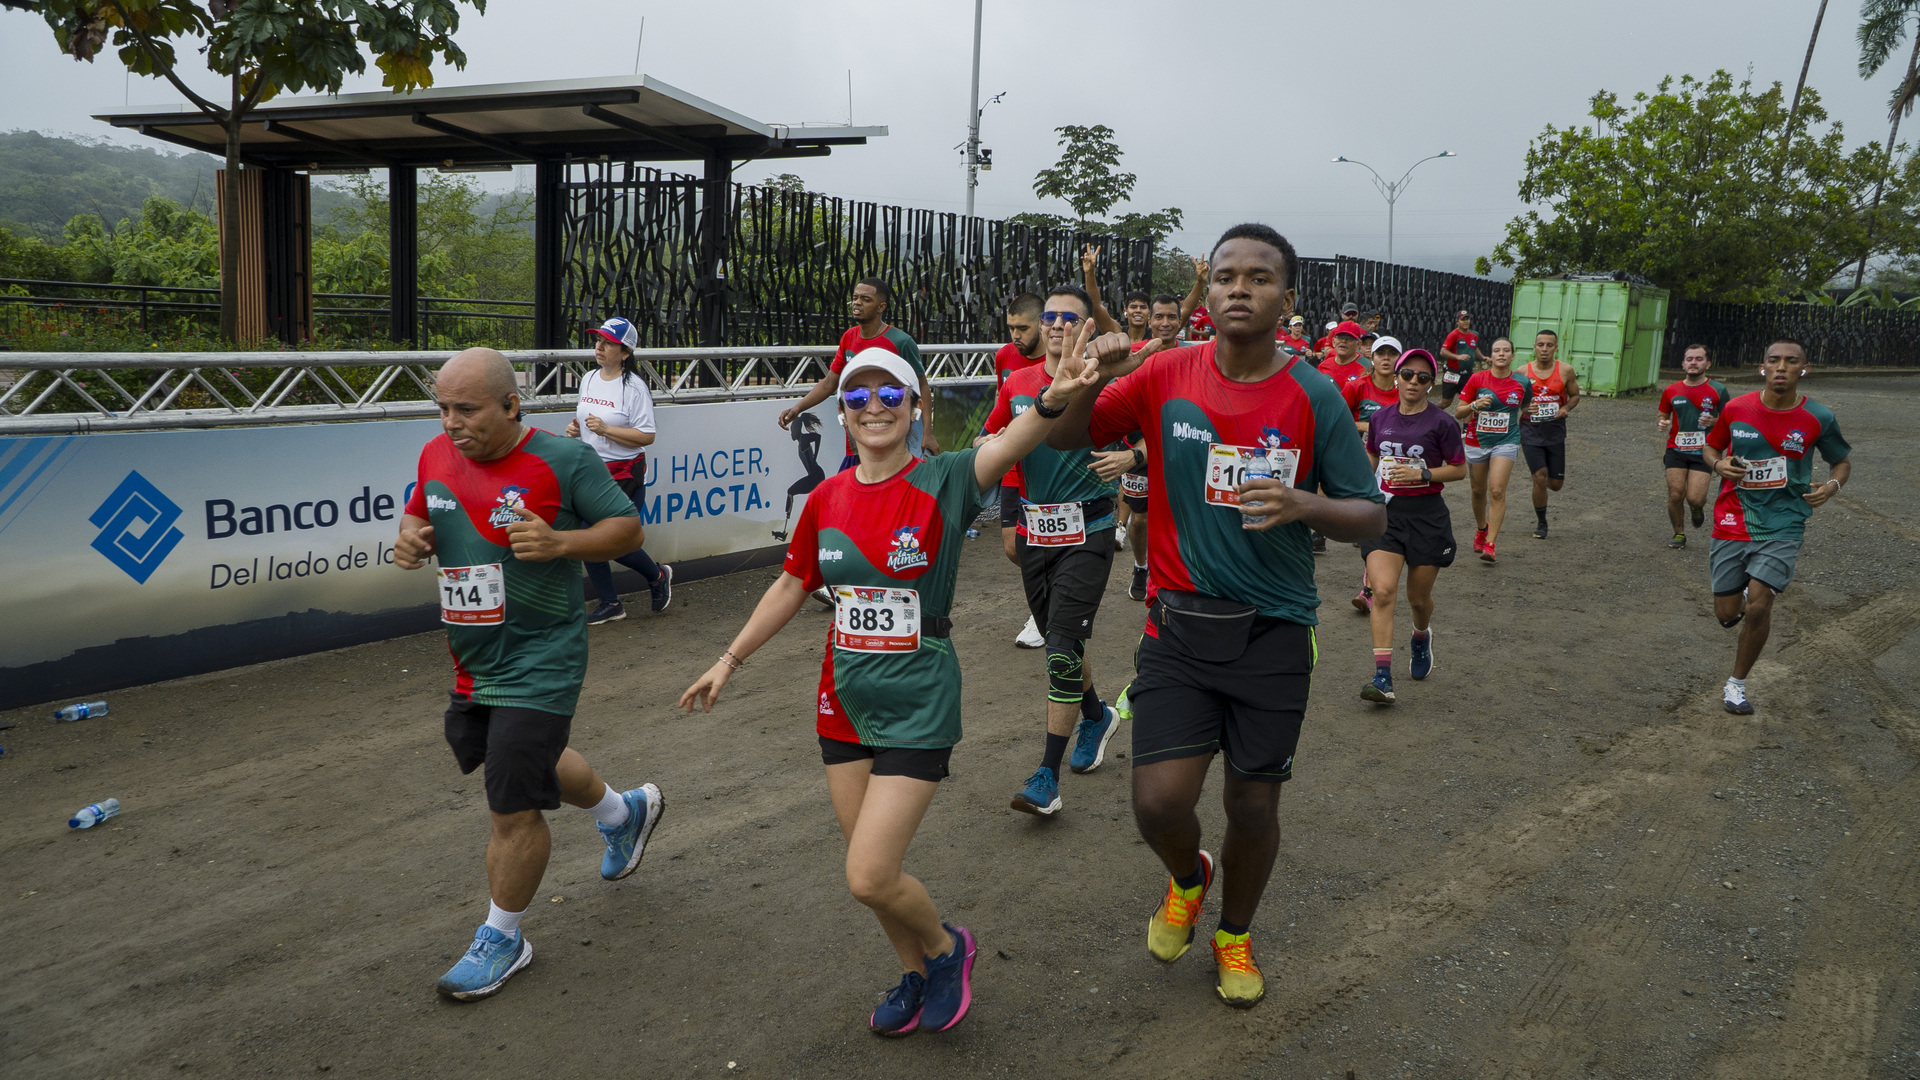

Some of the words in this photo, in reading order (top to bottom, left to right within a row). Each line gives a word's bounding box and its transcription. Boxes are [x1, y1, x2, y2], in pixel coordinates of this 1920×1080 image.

[581, 396, 615, 409] HONDA
[1535, 409, 1555, 417] 353
[1482, 418, 1503, 427] 2109
[671, 447, 770, 484] HACER,
[1223, 464, 1281, 486] 106
[1747, 468, 1773, 481] 187
[205, 498, 339, 540] Banco
[349, 486, 395, 523] de
[641, 482, 771, 526] MPACTA.
[1038, 517, 1067, 533] 885
[210, 558, 259, 589] Del
[268, 551, 330, 582] lado
[336, 545, 368, 571] de
[443, 585, 482, 607] 714
[849, 607, 895, 632] 883
